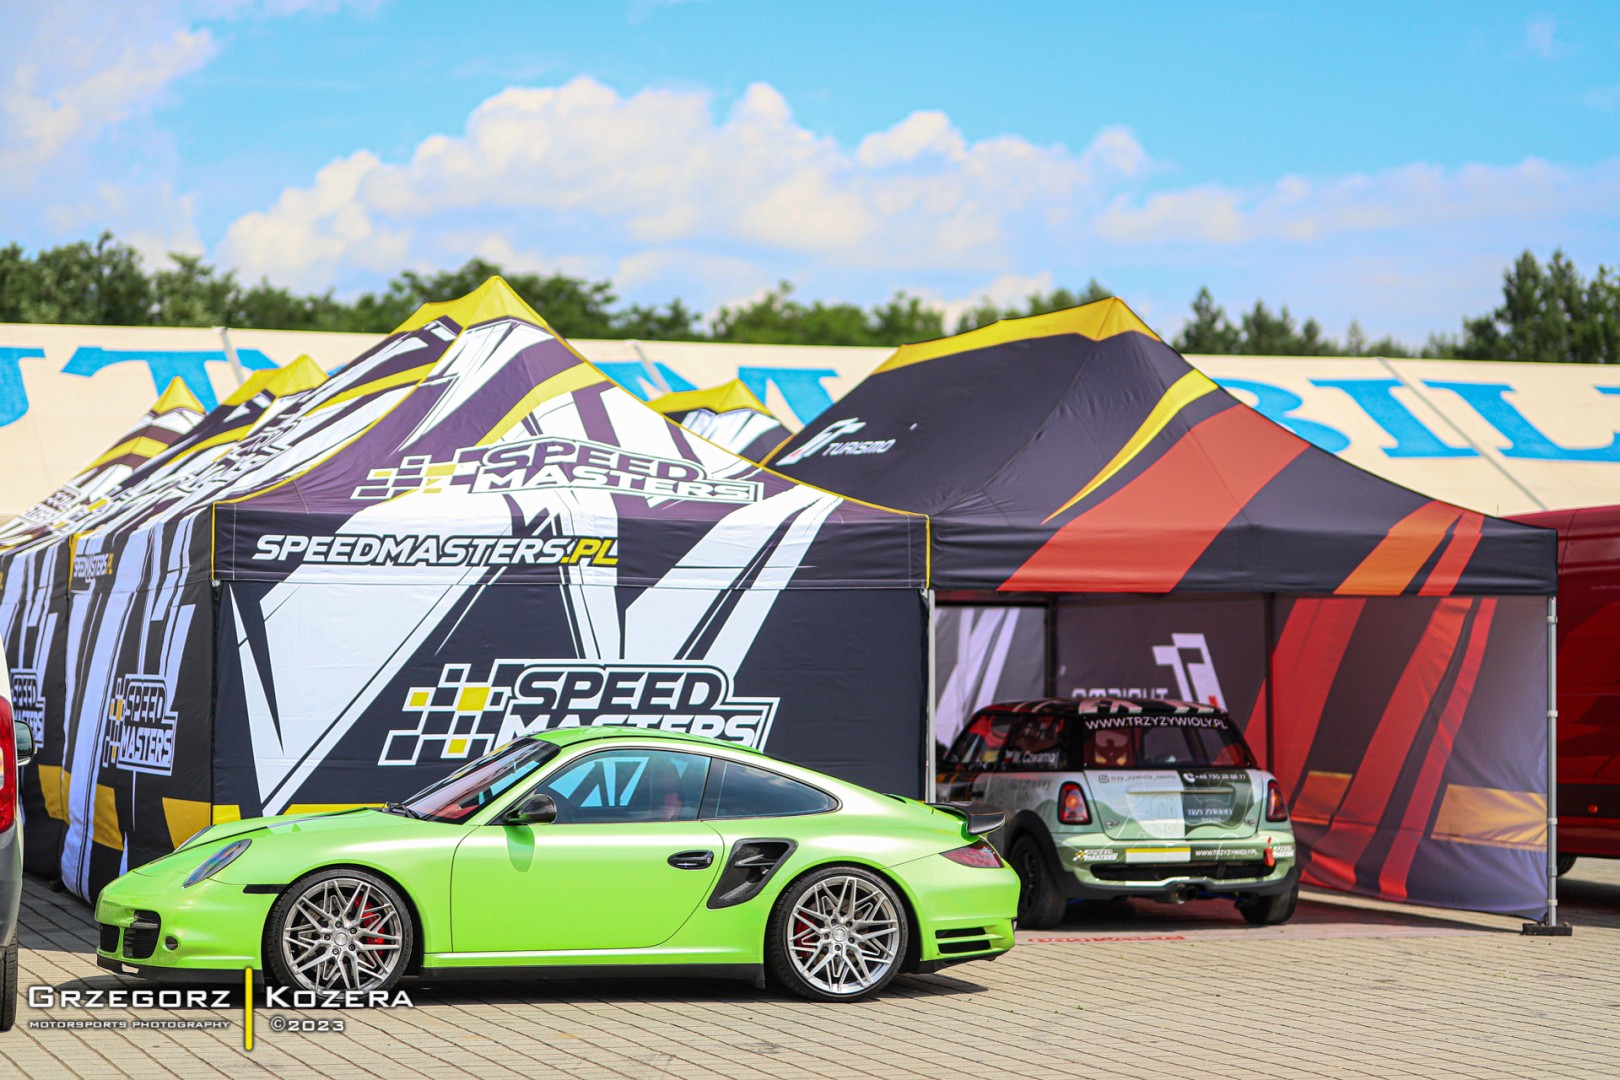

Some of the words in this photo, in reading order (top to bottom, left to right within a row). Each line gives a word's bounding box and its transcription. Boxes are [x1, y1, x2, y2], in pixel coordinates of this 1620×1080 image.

[481, 443, 703, 482] SPEED
[822, 439, 896, 456] TURISMO
[475, 465, 752, 500] MASTERS
[252, 534, 619, 566] SPEEDMASTERS.PL
[126, 684, 166, 723] SPEED
[515, 671, 723, 710] SPEED
[119, 725, 173, 765] MASTERS
